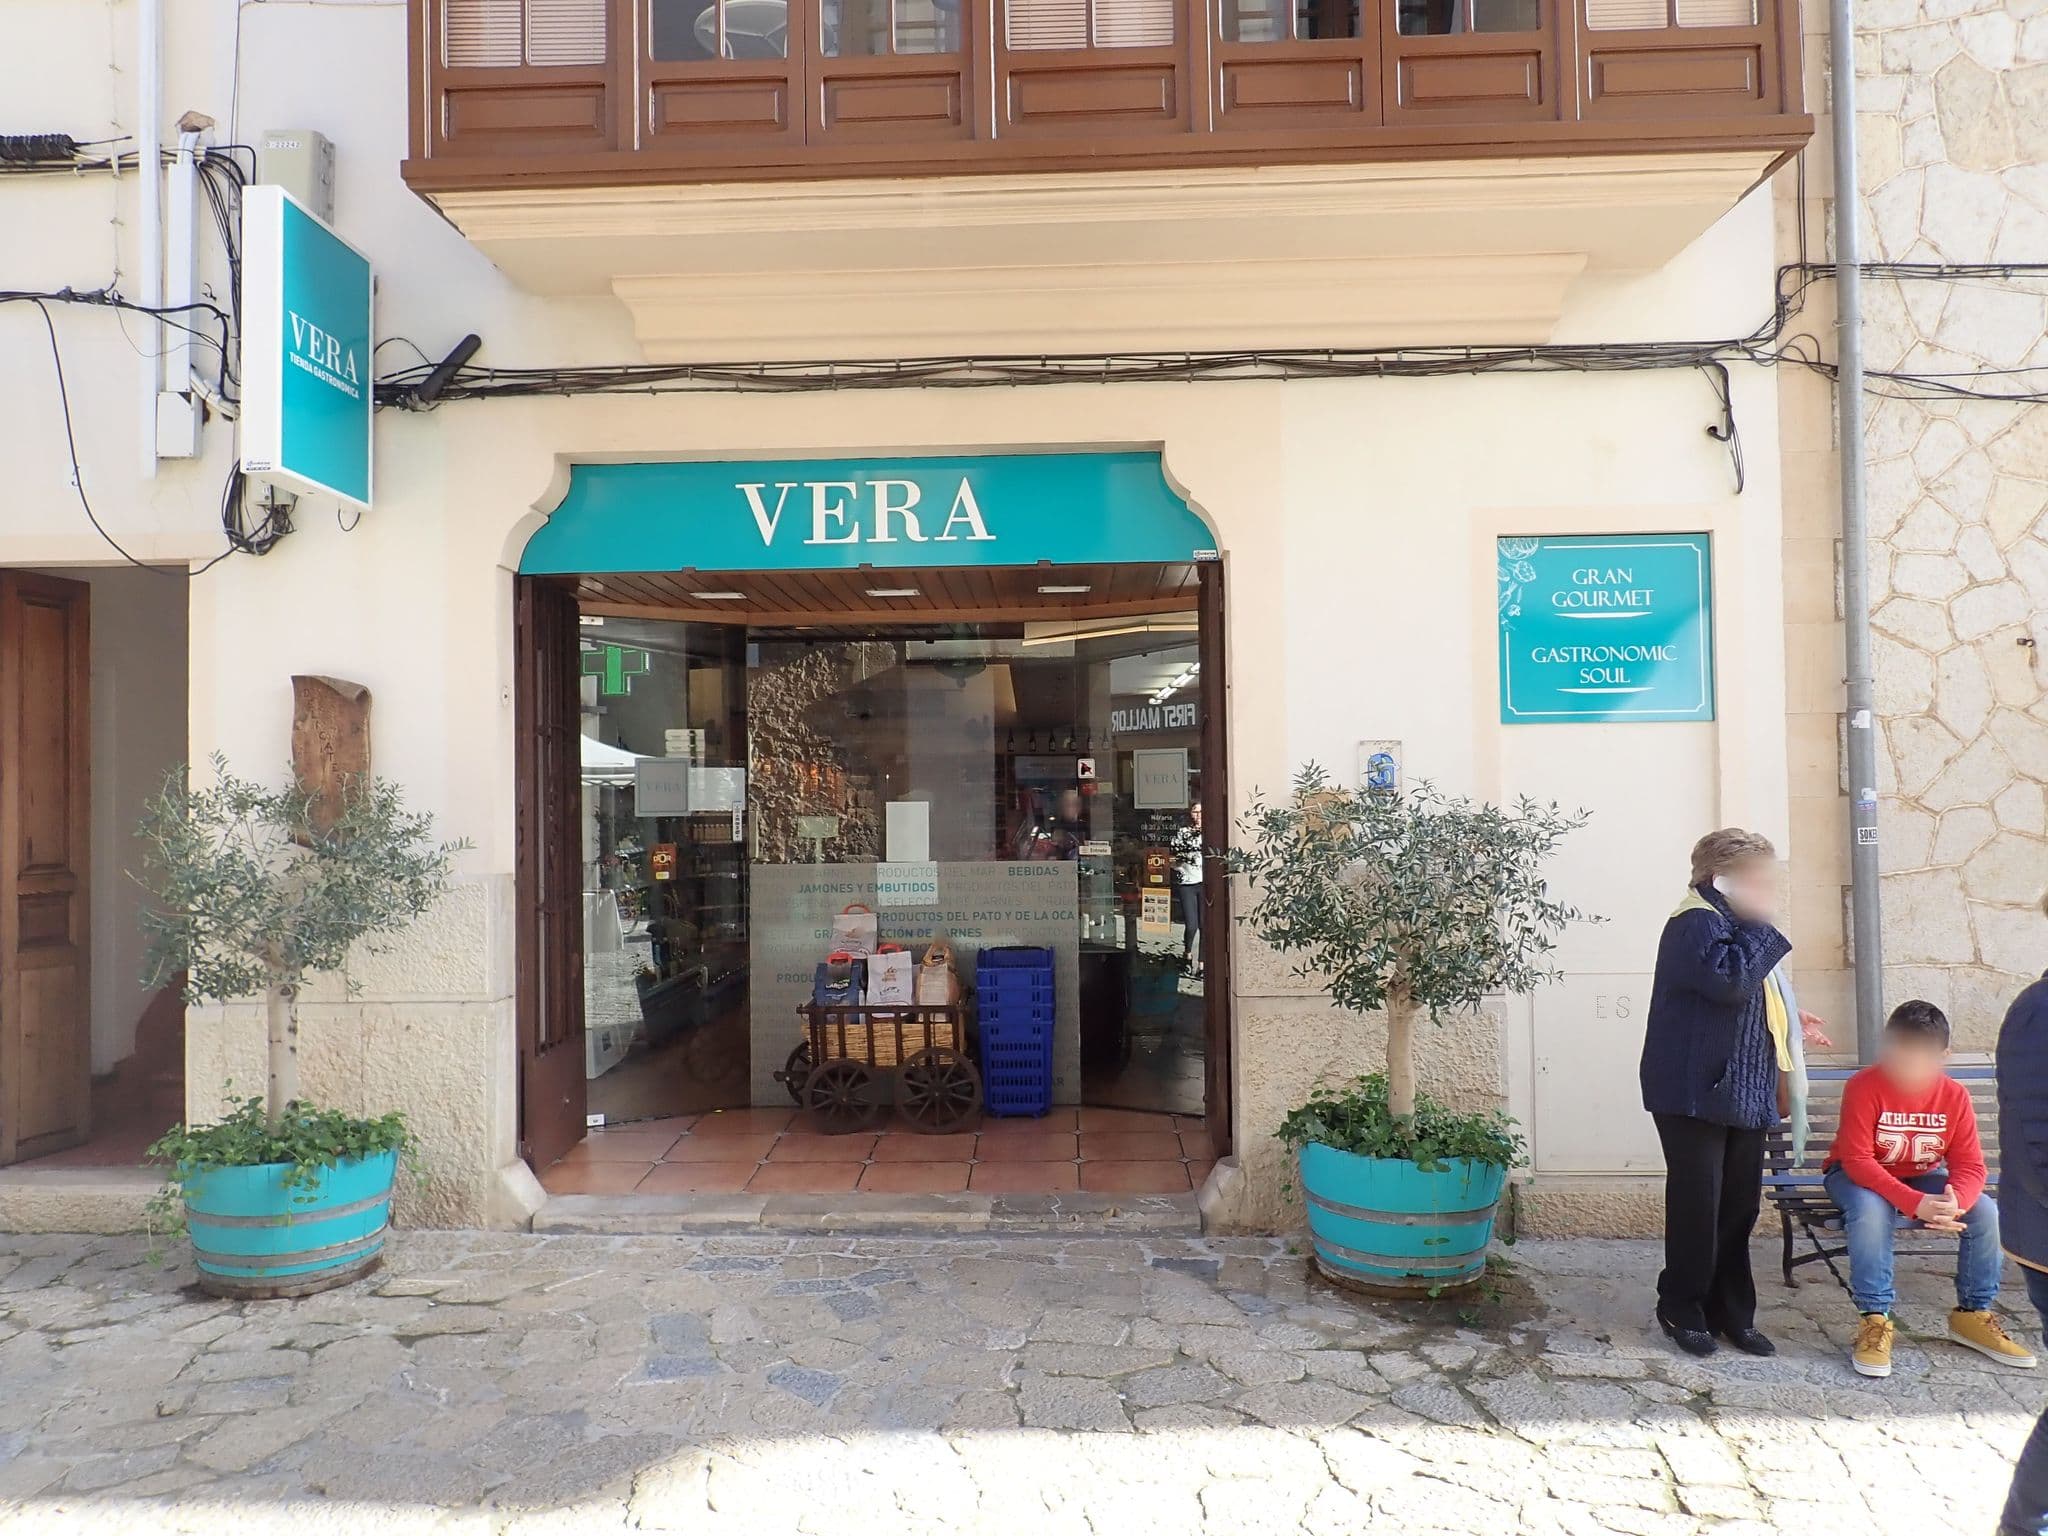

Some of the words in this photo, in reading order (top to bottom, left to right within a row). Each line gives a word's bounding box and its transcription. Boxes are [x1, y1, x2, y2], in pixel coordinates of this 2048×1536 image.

[289, 310, 359, 385] VERA
[289, 351, 313, 374] TIENDA
[735, 476, 997, 546] VERA
[1572, 567, 1632, 584] GRAN
[1552, 589, 1655, 607] GOURMET
[1531, 645, 1679, 663] GASTRONOMIC
[1580, 667, 1631, 683] SOUL
[1145, 774, 1177, 784] VERA
[1008, 866, 1059, 876] BEBIDAS
[798, 882, 854, 894] JAMONES
[856, 883, 864, 893] Y
[867, 882, 935, 893] EMBUTIDOS
[877, 911, 944, 922] PRODUCTOS
[946, 911, 969, 921] DEL
[973, 911, 1001, 921] PATO
[1003, 911, 1012, 921] Y
[1015, 911, 1031, 920] DE
[1033, 911, 1049, 920] LA
[1052, 910, 1075, 920] OCA
[917, 928, 933, 938] DE
[1879, 1111, 1947, 1127] ATHLETICS
[1876, 1130, 1945, 1164] 76
